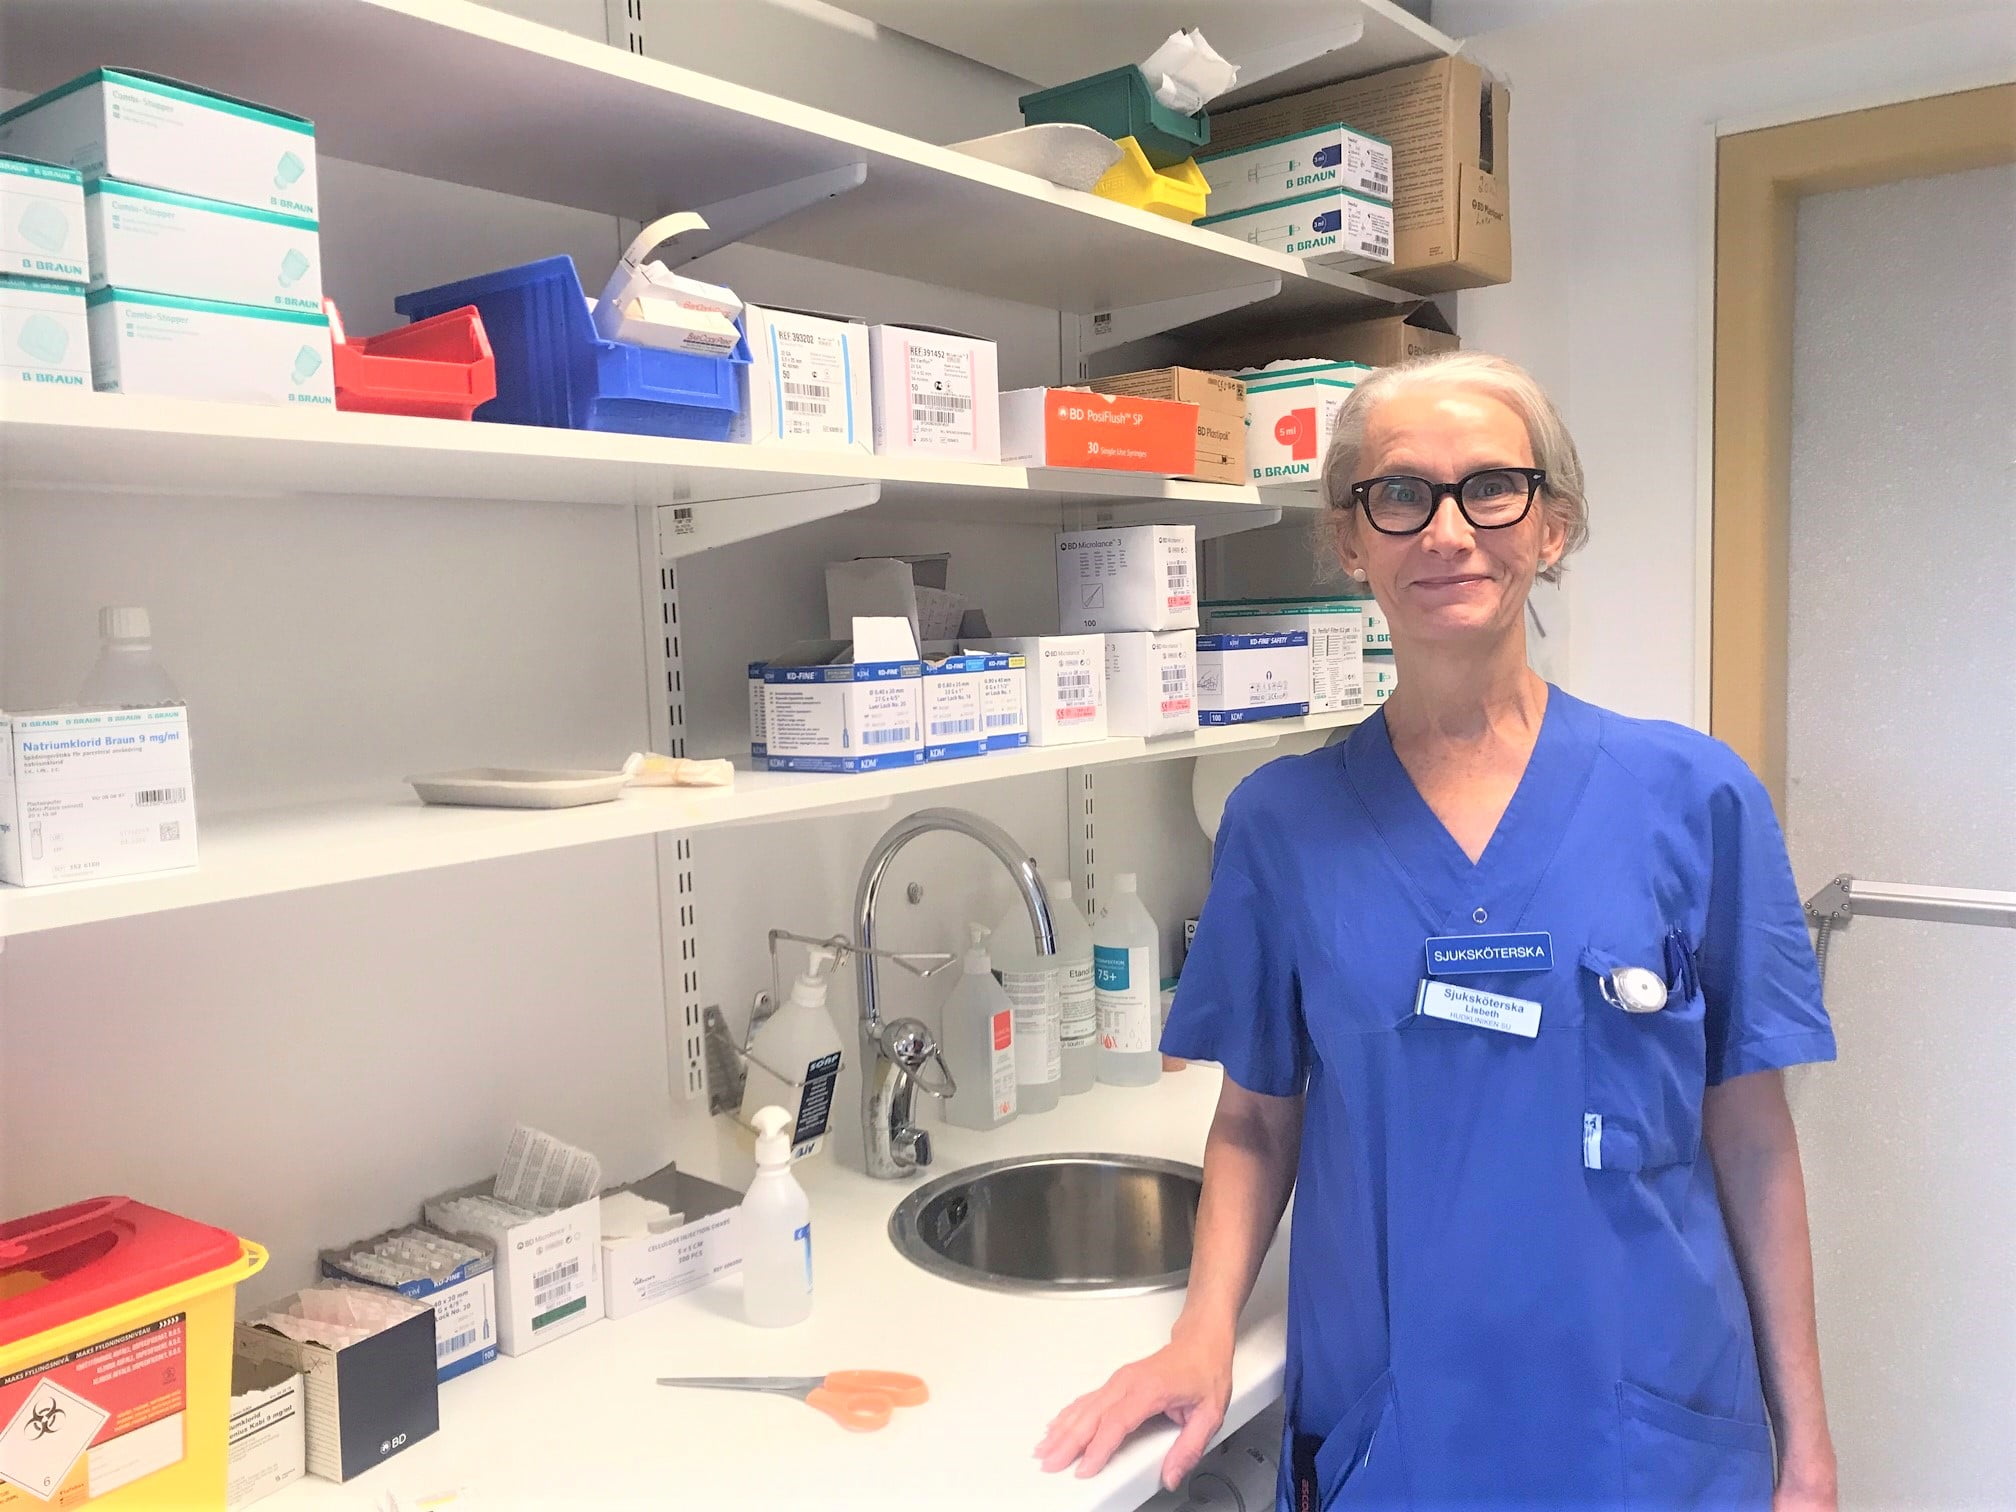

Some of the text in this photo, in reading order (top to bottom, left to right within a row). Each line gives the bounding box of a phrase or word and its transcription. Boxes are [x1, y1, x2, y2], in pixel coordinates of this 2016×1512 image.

[1286, 170, 1336, 189] B BRAUN
[271, 196, 314, 214] B BRAUN
[1286, 235, 1336, 253] B BRAUN
[22, 259, 82, 275] B BRAUN
[274, 296, 319, 310] B BRAUN
[778, 331, 814, 344] REF 393202
[910, 346, 945, 359] REF 391452
[22, 372, 83, 385] B BRAUN
[783, 370, 790, 379] 50
[288, 393, 332, 405] B BRAUN
[1069, 408, 1084, 421] BD
[1133, 413, 1144, 426] SP
[1197, 426, 1206, 436] BD
[1279, 427, 1296, 437] 5 ml
[1087, 442, 1099, 454] 30
[1253, 464, 1310, 479] B BRAUN
[1068, 542, 1077, 550] BD
[1271, 636, 1287, 644] SAFETY
[1366, 634, 1374, 642] B
[786, 672, 815, 680] KD-FINE
[30, 720, 59, 728] BRAUN
[73, 717, 101, 725] BRAUN
[115, 714, 141, 722] BRAUN
[23, 731, 179, 752] Natriumklorid Braun 9 mg/ml
[845, 761, 855, 769] 100
[1434, 946, 1545, 962] SJUKSKÖTERSKA
[1098, 969, 1117, 981] 75+
[1444, 987, 1525, 1014] Sjuksköterska
[1465, 1004, 1500, 1018] Lisbeth
[1450, 1011, 1499, 1028] HUDKLINIKEN
[647, 1237, 680, 1253] CELLULOSE
[693, 1240, 704, 1250] CM
[691, 1249, 703, 1260] PCS
[457, 1290, 469, 1298] mm
[4, 1373, 24, 1385] MAKS
[25, 1356, 70, 1377] FYLLINGSNIVÅ
[76, 1347, 94, 1359] MAKS
[95, 1327, 151, 1352] FYLDNINGSNIVEAU
[484, 1349, 495, 1360] 100
[229, 1411, 261, 1431] iumklorid
[229, 1427, 249, 1440] enius
[249, 1417, 265, 1429] Kabi
[391, 1433, 407, 1449] BD
[43, 1477, 51, 1487] 6
